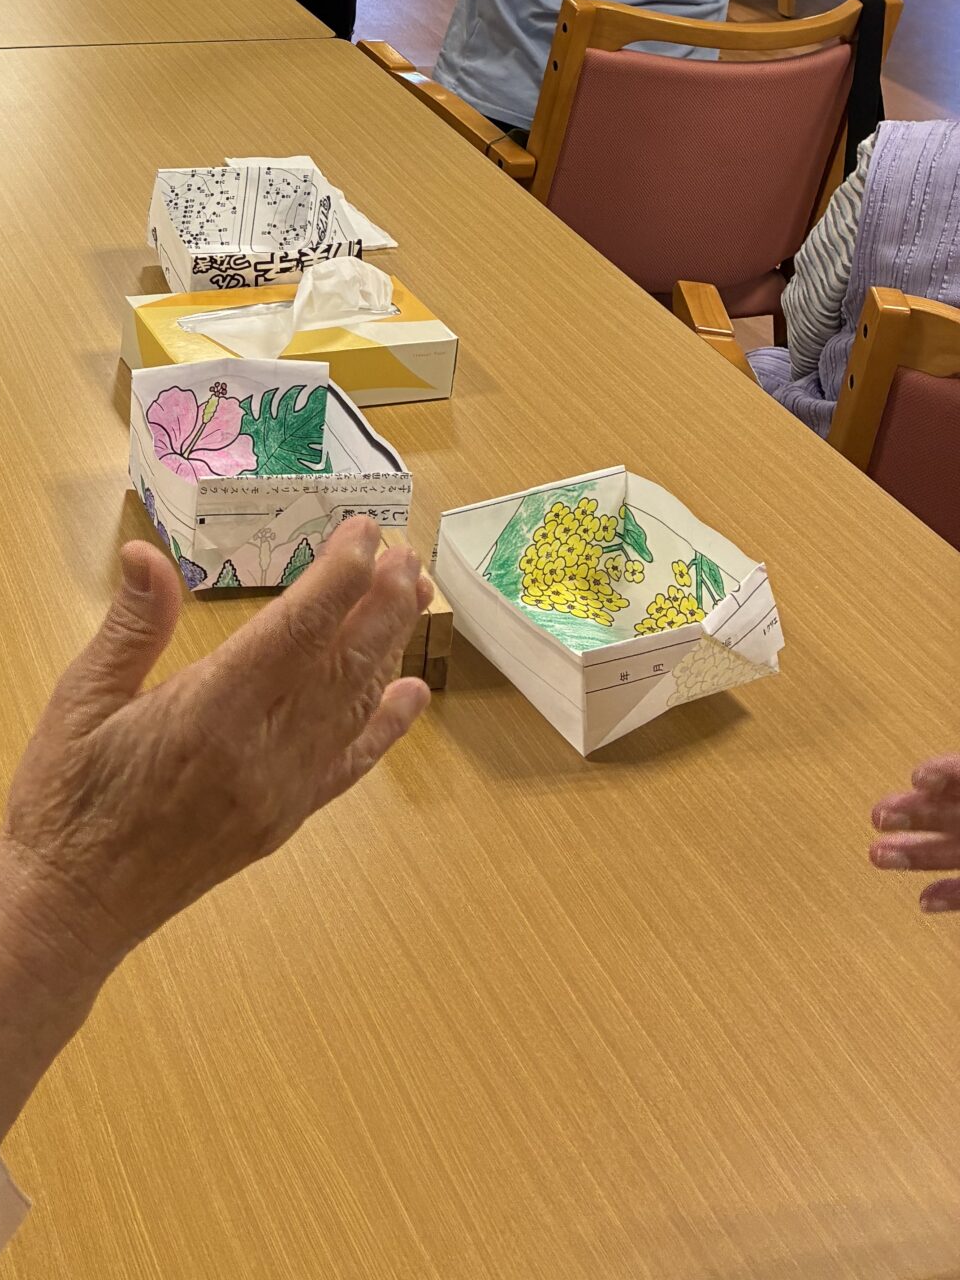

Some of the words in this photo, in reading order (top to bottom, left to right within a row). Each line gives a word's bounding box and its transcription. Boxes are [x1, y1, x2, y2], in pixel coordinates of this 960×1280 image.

[193, 254, 251, 275] つなぎ
[619, 671, 630, 682] 年
